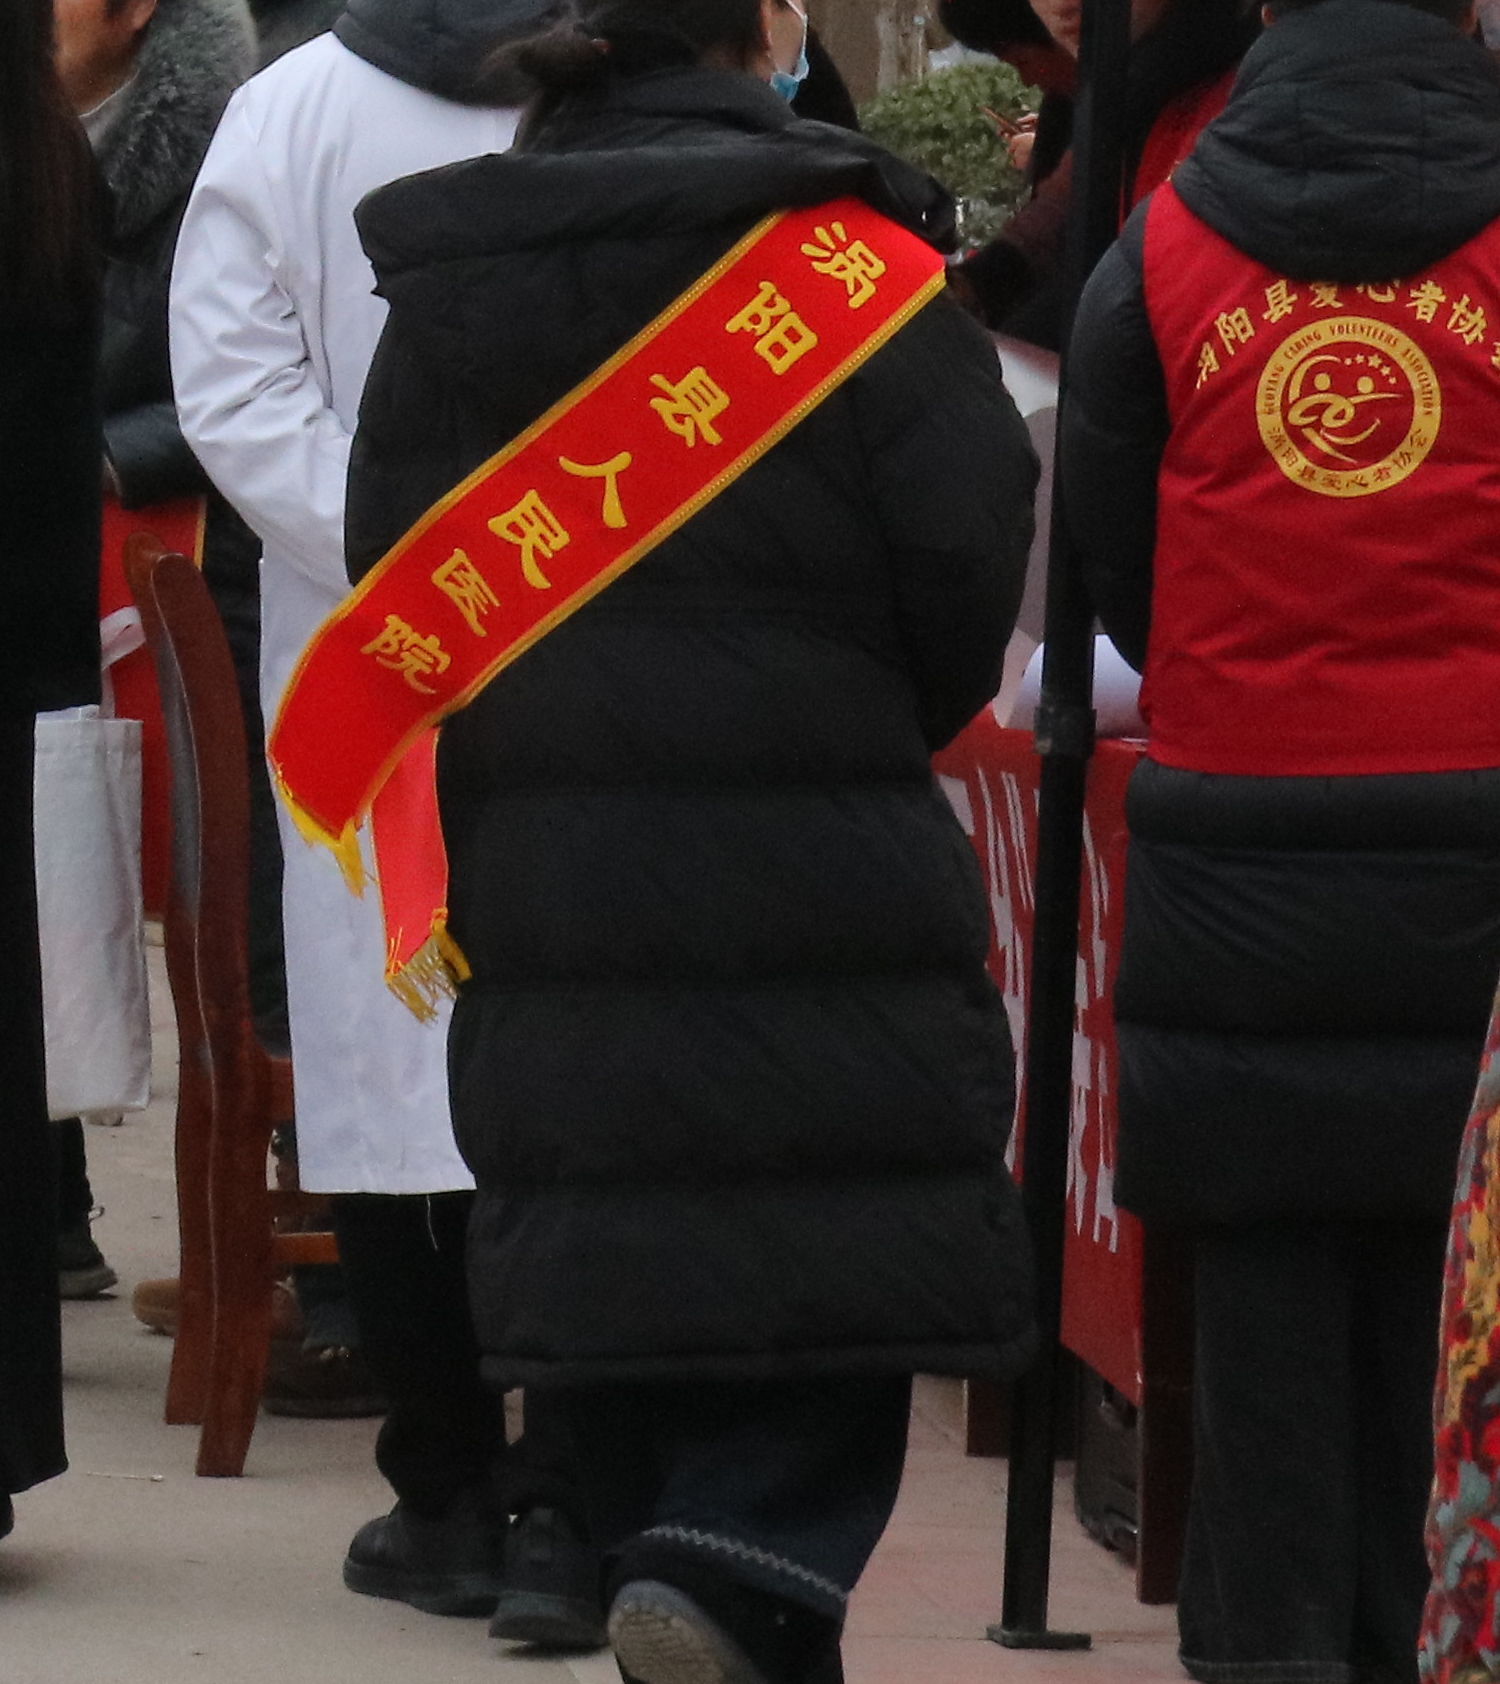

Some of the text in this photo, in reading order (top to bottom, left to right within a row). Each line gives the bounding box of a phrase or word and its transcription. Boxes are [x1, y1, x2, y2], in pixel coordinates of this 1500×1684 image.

[359, 219, 891, 698] 涡阳县人民医院
[1283, 328, 1323, 361] CARING
[1329, 322, 1400, 347] VOLUNTEERS
[1401, 347, 1435, 417] ASSOCIATION
